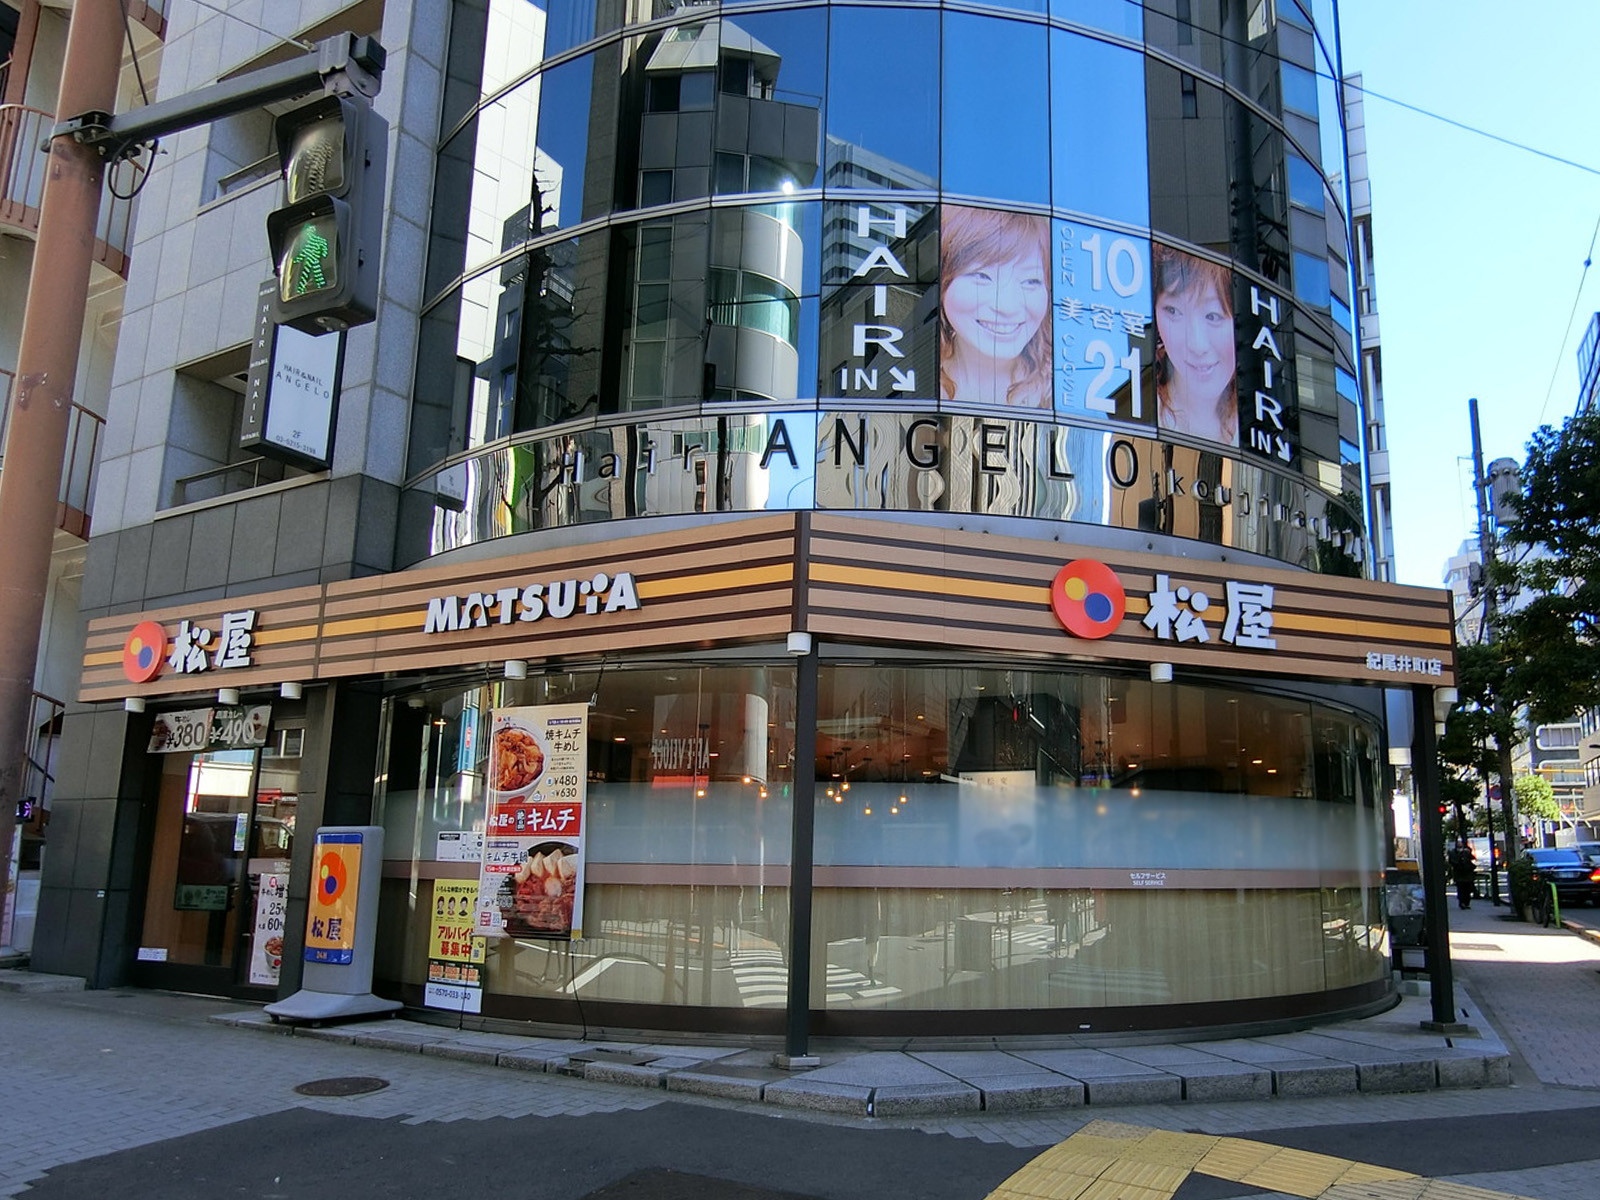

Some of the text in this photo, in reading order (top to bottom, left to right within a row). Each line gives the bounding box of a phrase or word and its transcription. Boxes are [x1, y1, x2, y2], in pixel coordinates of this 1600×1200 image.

[1061, 225, 1075, 287] OPEN
[1081, 233, 1143, 298] 10
[853, 207, 909, 358] HAIR
[1059, 297, 1146, 338] 美容室
[1062, 334, 1075, 408] CLOSE
[1250, 286, 1284, 431] HAIR
[275, 371, 330, 399] ANGELO
[841, 368, 878, 391] IN
[1084, 340, 1142, 419] 21
[560, 440, 703, 486] Hair
[759, 418, 1140, 490] ANGELO
[1250, 427, 1272, 455] IN
[1143, 574, 1277, 650] 松屋
[169, 610, 256, 674] 松屋
[1366, 651, 1442, 677] 紀尾井町店
[166, 721, 206, 749] ¥380
[209, 719, 255, 745] ¥490
[545, 728, 581, 741] 焼キムチ
[554, 741, 579, 752] 牛めし
[527, 808, 575, 831] キムチ
[312, 915, 342, 941] 松屋
[441, 941, 472, 957] 募集中
